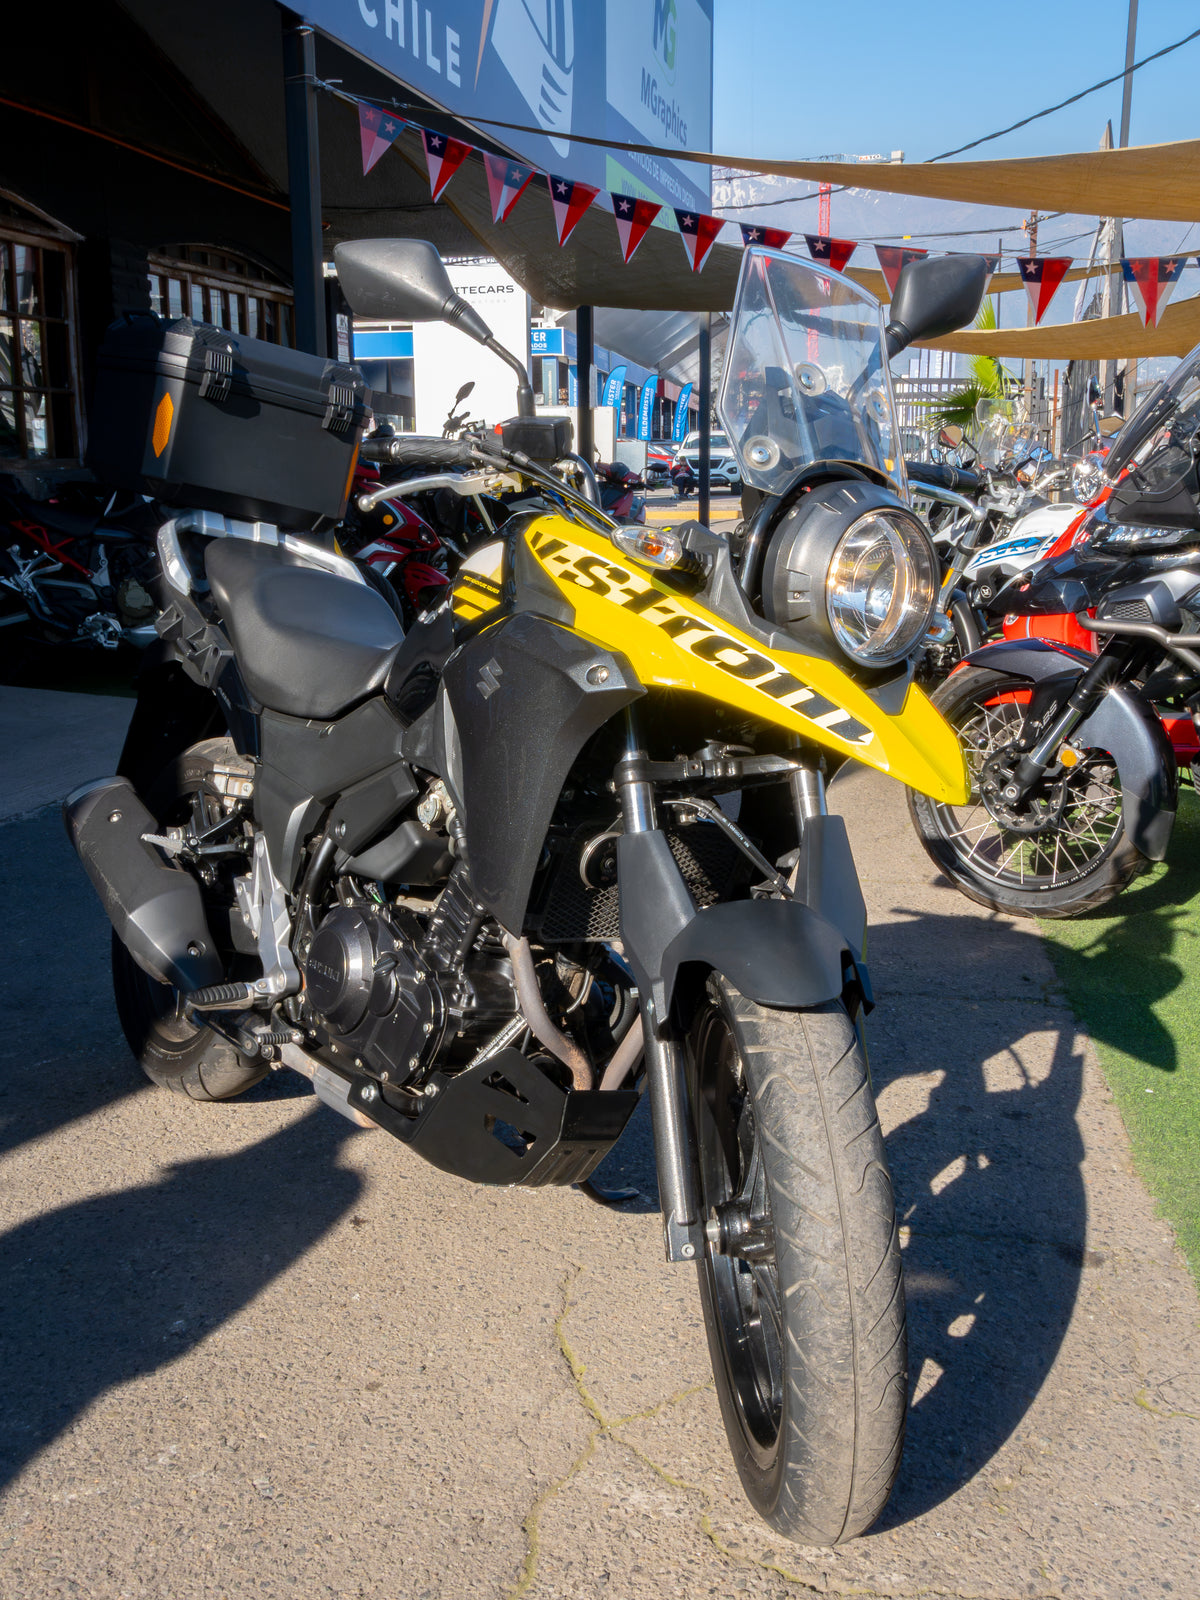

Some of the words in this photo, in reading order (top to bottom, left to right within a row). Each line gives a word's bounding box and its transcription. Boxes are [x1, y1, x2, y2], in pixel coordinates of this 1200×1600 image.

[641, 66, 688, 147] MGraphics
[641, 387, 651, 437] GILDEMEISTER
[1042, 699, 1058, 726] ABS
